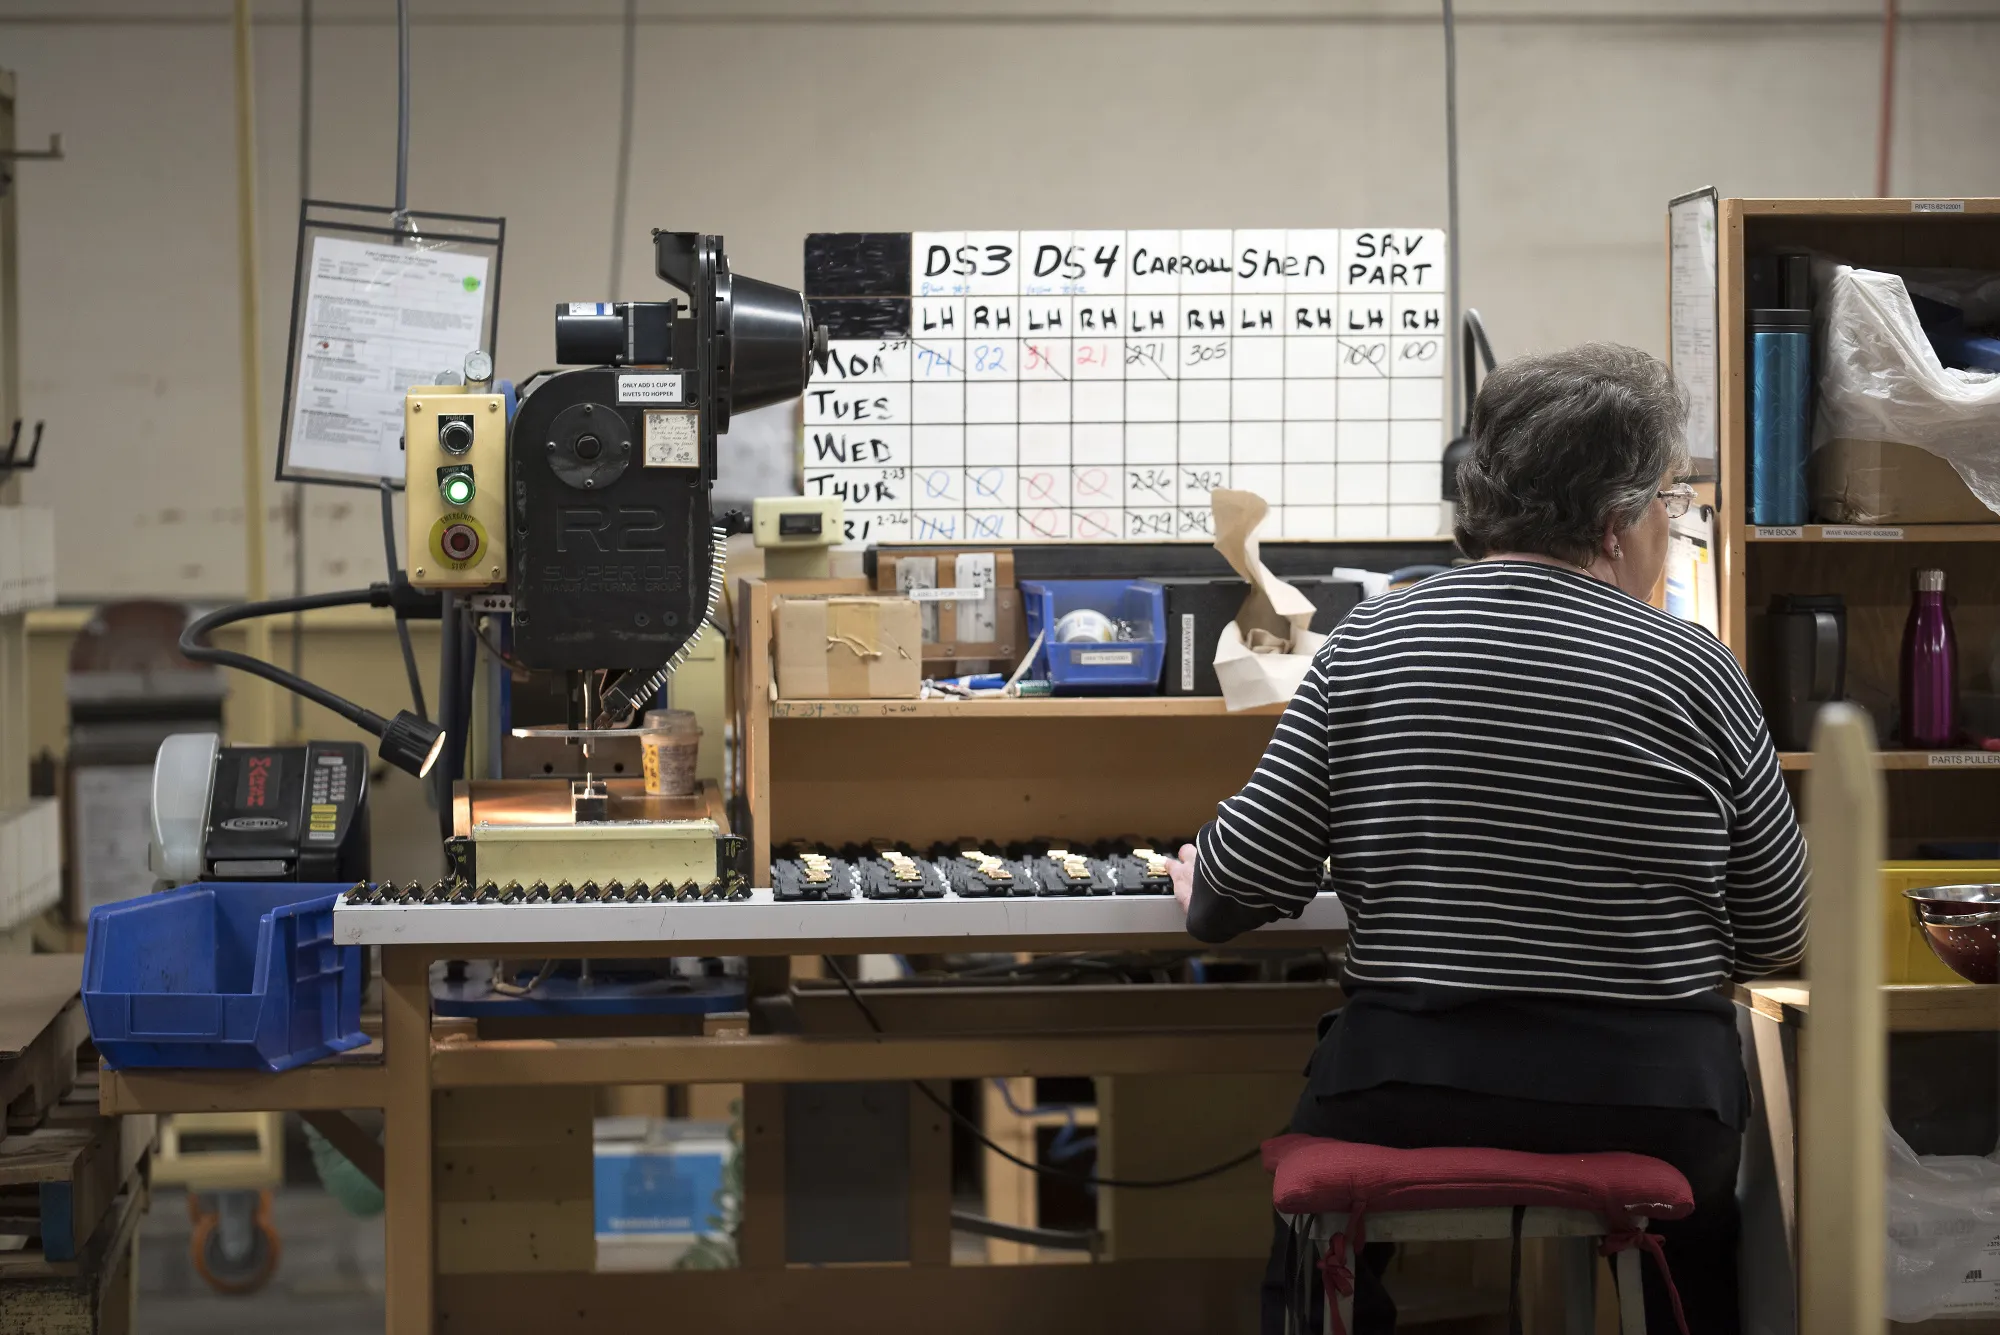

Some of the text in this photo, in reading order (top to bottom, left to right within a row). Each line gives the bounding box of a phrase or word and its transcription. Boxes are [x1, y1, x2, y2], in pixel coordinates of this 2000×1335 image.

[1356, 232, 1423, 258] SRV
[924, 244, 1013, 277] DS3
[1033, 244, 1119, 279] DS4
[1238, 248, 1325, 279] Shen
[1349, 263, 1432, 286] PART
[922, 305, 1440, 332] LH RH LH RH LH RH LH RH LH RH
[974, 344, 1007, 372] 82
[1077, 343, 1107, 368] 21
[1185, 341, 1228, 366] 305
[1398, 340, 1437, 362] 100
[808, 389, 893, 420] TUES
[813, 433, 892, 464] WED
[807, 473, 895, 504] THUR
[440, 512, 475, 525] EMERGENCY
[556, 503, 666, 552] R2
[1758, 528, 1797, 536] TPM BOOK
[451, 562, 468, 570] STOP
[542, 565, 683, 582] SUPERIOR
[645, 582, 683, 593] GROUP
[1931, 755, 1963, 764] PARTS
